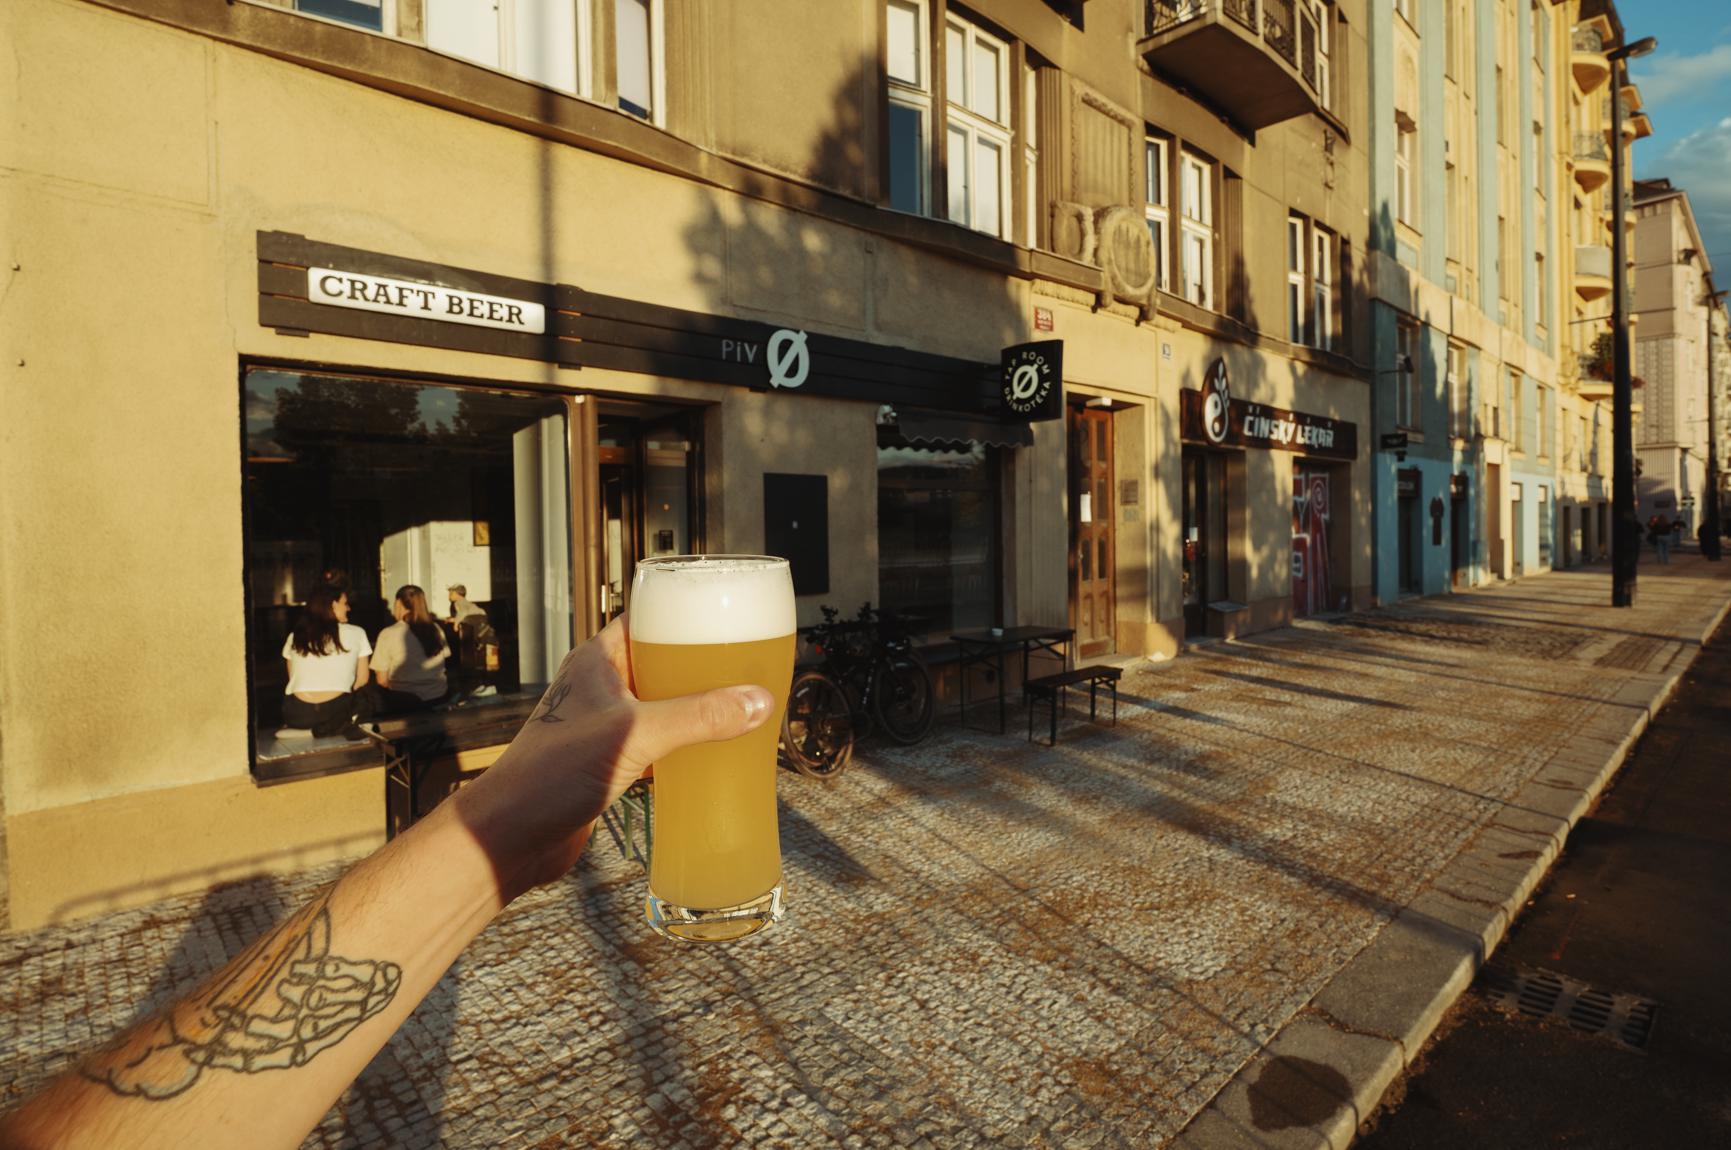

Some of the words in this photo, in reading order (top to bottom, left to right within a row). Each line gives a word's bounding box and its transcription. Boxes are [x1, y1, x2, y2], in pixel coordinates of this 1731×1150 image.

[320, 275, 436, 311] CRAFT
[445, 294, 525, 326] BEER
[1004, 358, 1017, 380] TAP
[1022, 351, 1051, 374] ROOM
